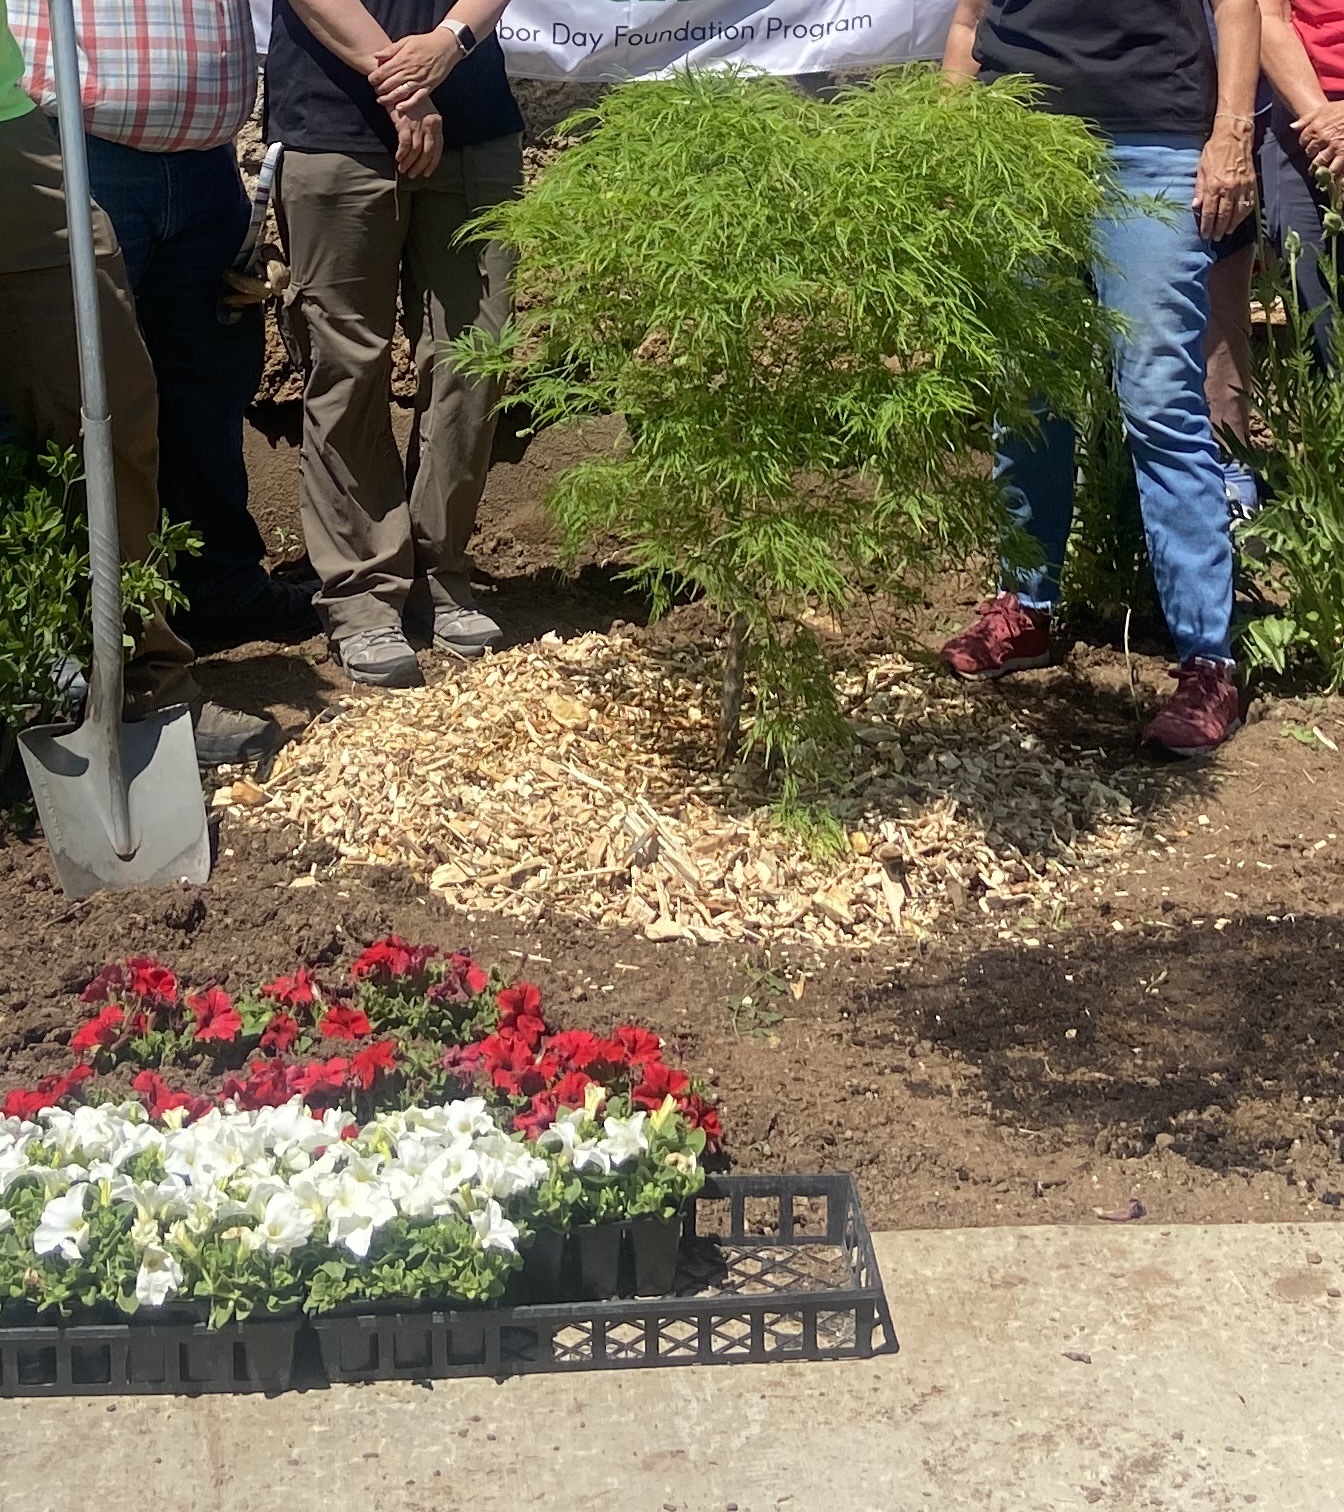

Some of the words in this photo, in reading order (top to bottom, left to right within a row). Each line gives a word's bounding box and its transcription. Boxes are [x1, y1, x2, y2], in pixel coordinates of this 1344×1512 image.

[499, 19, 542, 42] bor
[552, 22, 604, 54] Day
[614, 20, 754, 47] Foundation
[766, 14, 873, 42] Program
